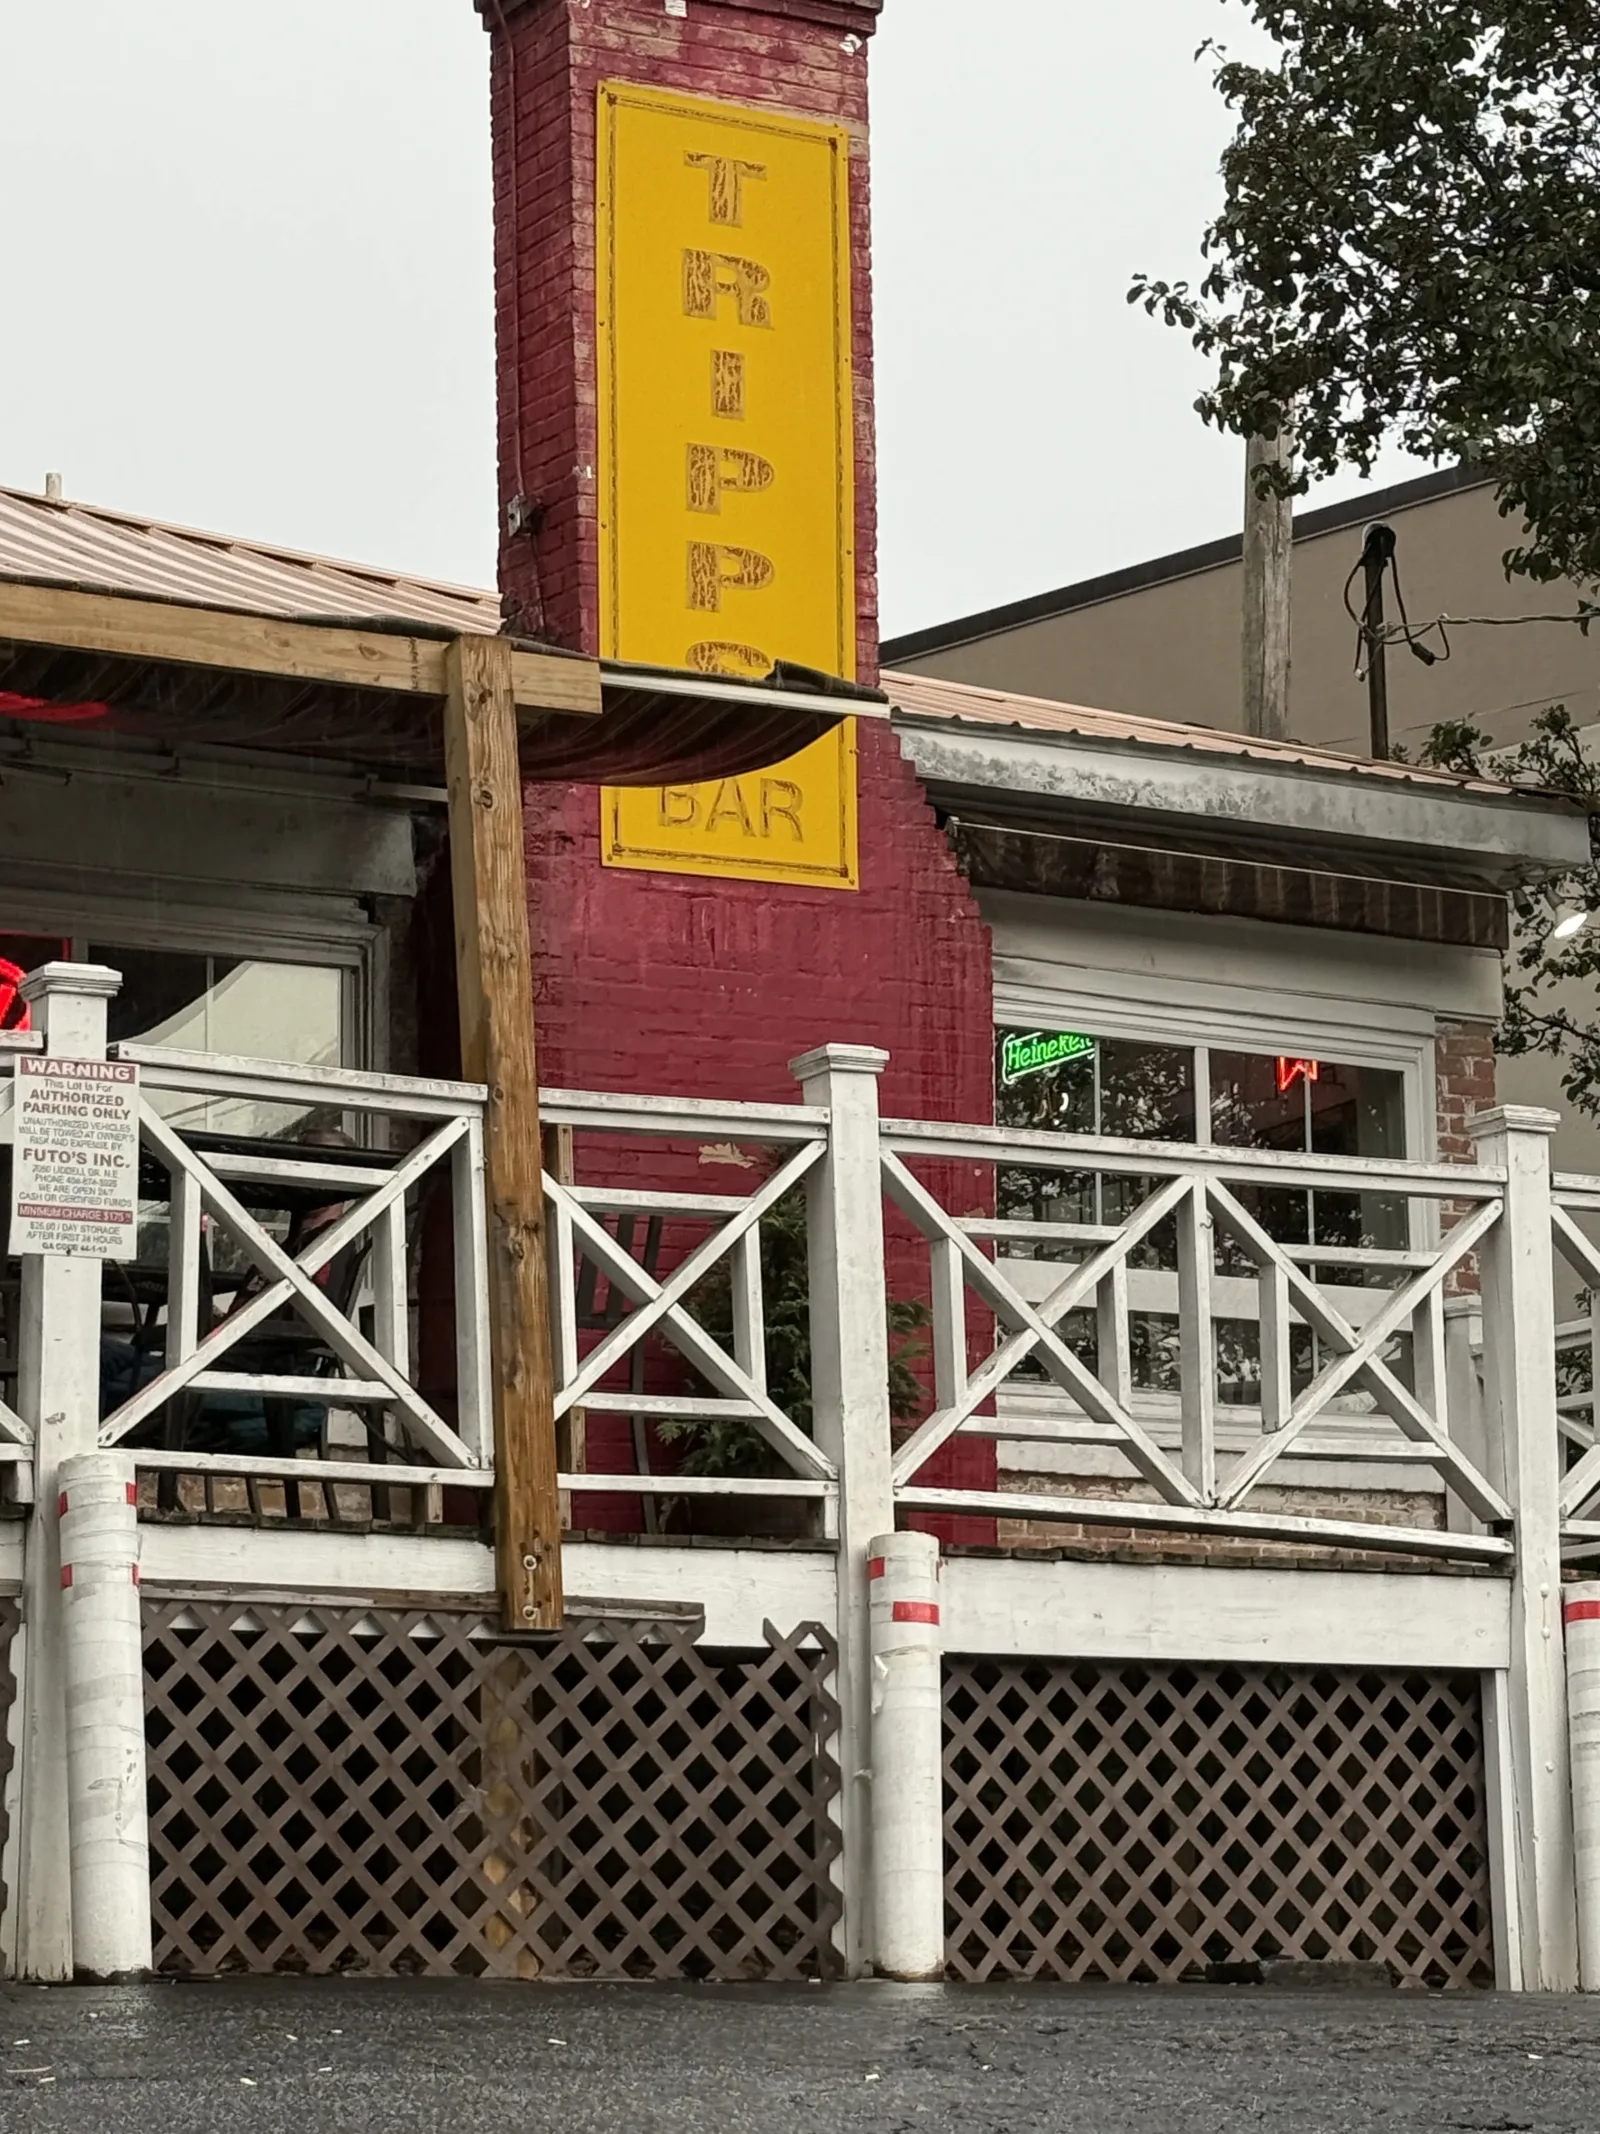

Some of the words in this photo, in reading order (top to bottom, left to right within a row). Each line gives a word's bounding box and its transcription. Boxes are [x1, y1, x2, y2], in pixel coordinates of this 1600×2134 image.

[658, 778, 805, 843] BAR
[26, 1058, 130, 1081] WARNING
[44, 1078, 64, 1089] This
[66, 1080, 82, 1090] Lot
[95, 1082, 113, 1093] For
[29, 1088, 124, 1107] AUTHORIZED
[22, 1101, 88, 1117] PARKING
[92, 1107, 131, 1121] ONLY
[22, 1117, 89, 1129] UNAUTHORIZED
[90, 1122, 131, 1133] VEHICLES
[18, 1125, 37, 1135] WILL
[39, 1127, 50, 1136] BE
[53, 1128, 84, 1139] TOWED
[84, 1130, 95, 1139] AT
[96, 1131, 136, 1143] OWNER'S
[29, 1136, 49, 1145] RISK
[51, 1137, 69, 1147] AND
[70, 1139, 109, 1150] EXPENSE
[111, 1142, 123, 1151] BY
[22, 1147, 88, 1165] FUTO'S
[93, 1152, 131, 1168] INC.
[34, 1173, 65, 1184] PHONE
[38, 1184, 51, 1192] WE
[53, 1185, 70, 1194] ARE
[72, 1186, 96, 1195] OPEN
[18, 1191, 43, 1201] CASH
[44, 1193, 57, 1202] OR
[104, 1198, 132, 1207] FUNDS
[62, 1209, 102, 1220] CHARGE
[62, 1223, 78, 1232] DAY
[80, 1225, 120, 1235] STORAGE
[26, 1231, 54, 1240] AFTER
[56, 1233, 80, 1242] FIRST
[93, 1235, 123, 1245] HOURS
[56, 1243, 78, 1252] CODE
